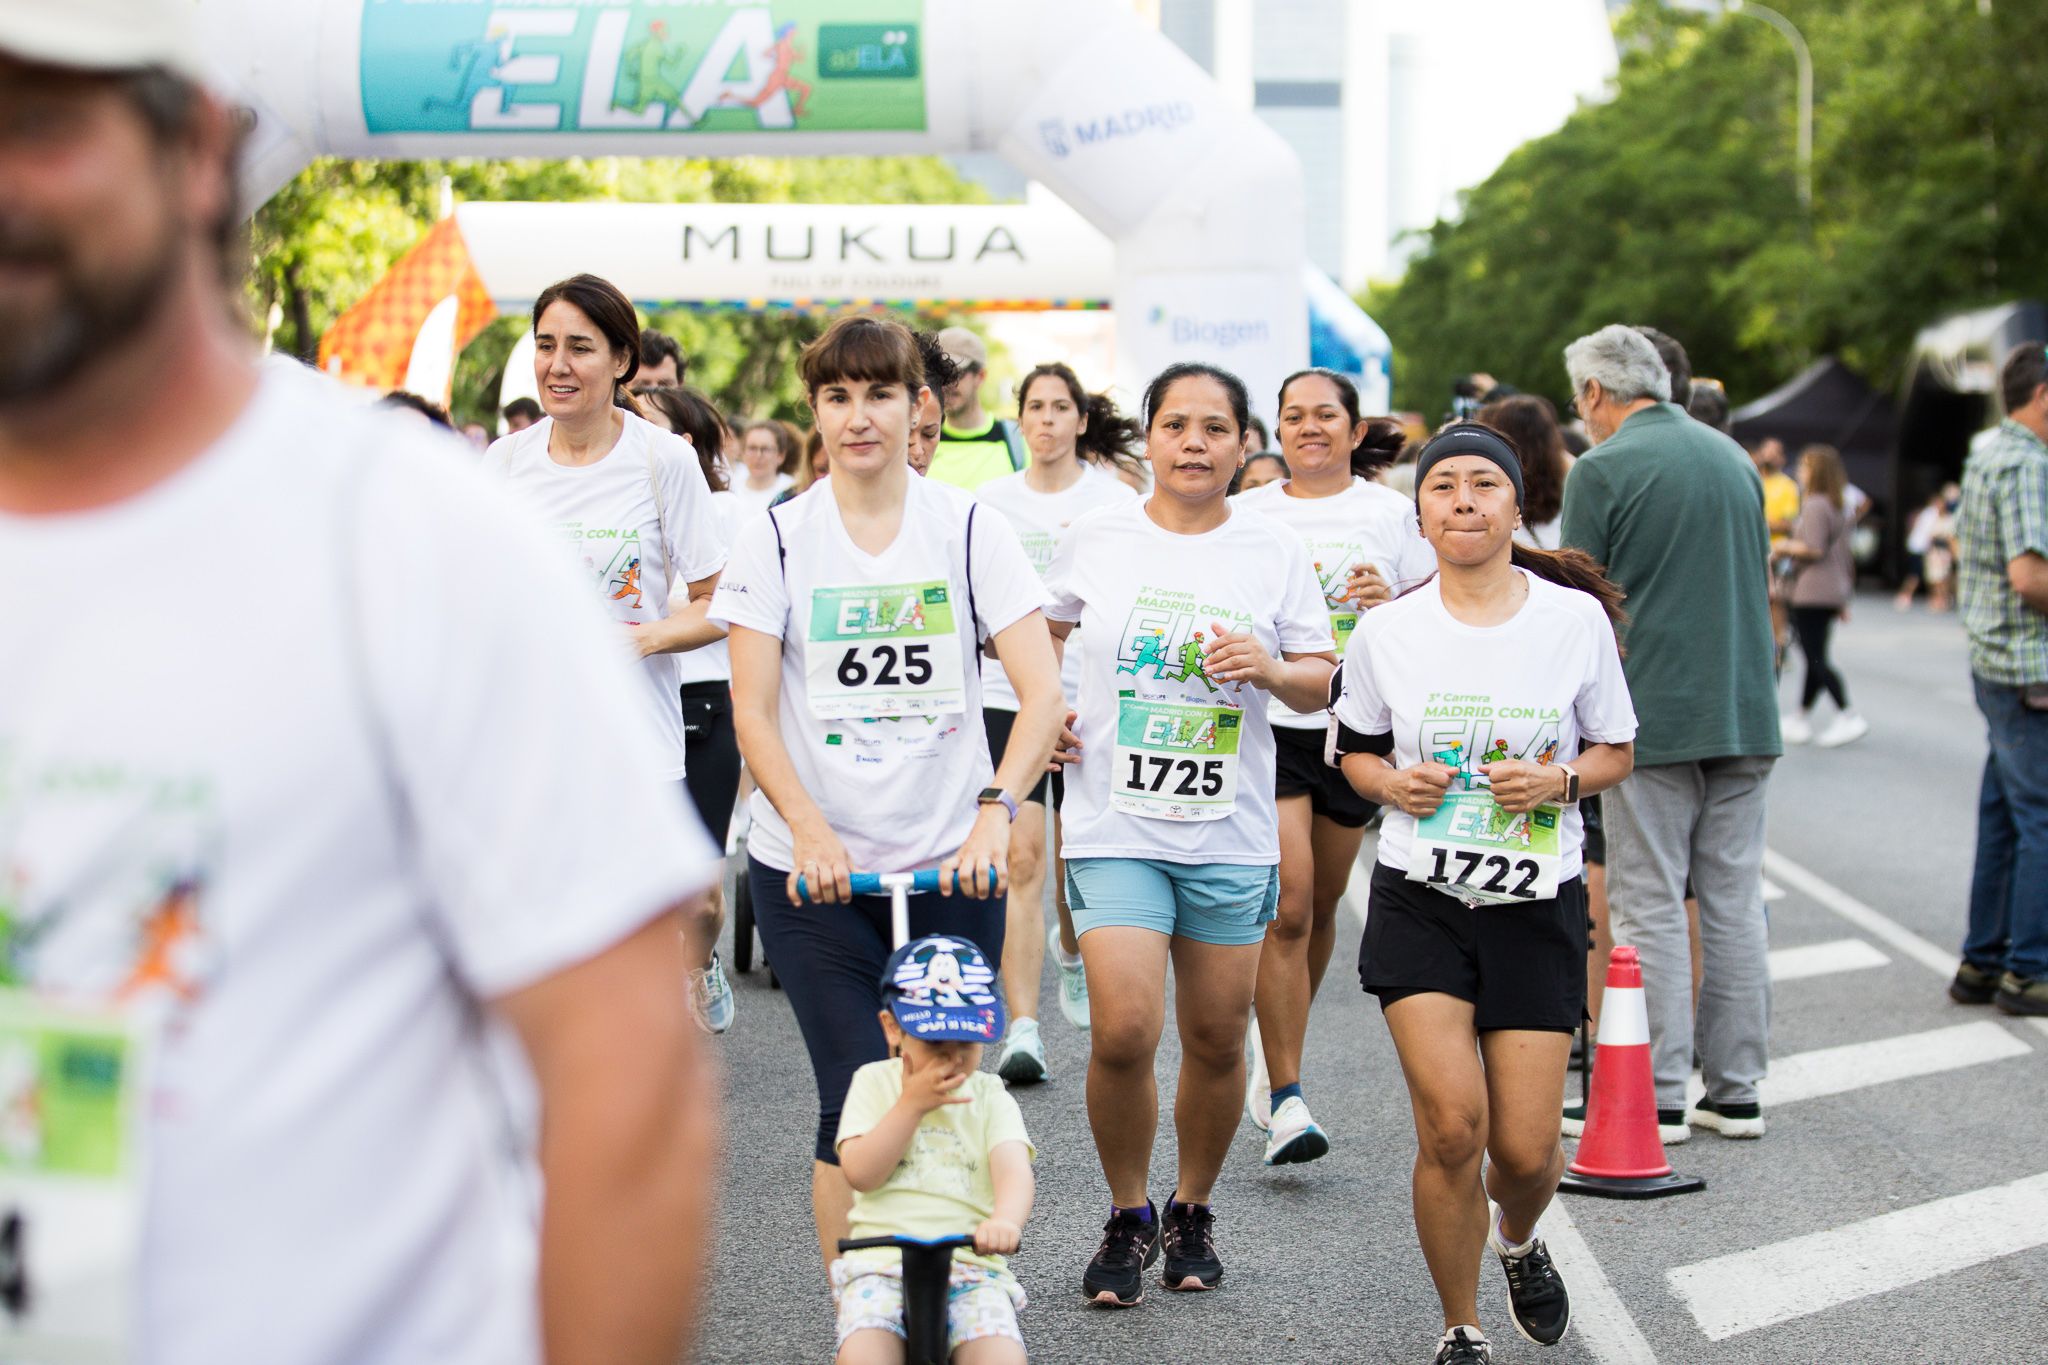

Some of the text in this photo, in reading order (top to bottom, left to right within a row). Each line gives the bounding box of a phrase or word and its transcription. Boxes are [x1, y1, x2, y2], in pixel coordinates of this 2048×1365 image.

[469, 9, 796, 129] ELA
[1074, 101, 1194, 146] MADRID
[684, 225, 1026, 261] MUKUA
[1172, 316, 1269, 350] Biogen
[587, 529, 618, 539] CON
[622, 529, 639, 539] LA
[1135, 597, 1253, 623] MADRID CON LA
[1155, 588, 1195, 600] Carrera
[837, 596, 925, 635] ELA
[837, 644, 933, 687] 625
[1424, 706, 1560, 719] MADRID CON LA
[1444, 693, 1490, 703] Carrera
[1142, 714, 1217, 750] ELA
[1127, 753, 1224, 796] 1725
[1446, 804, 1533, 847] ELA
[1427, 847, 1540, 899] 1722
